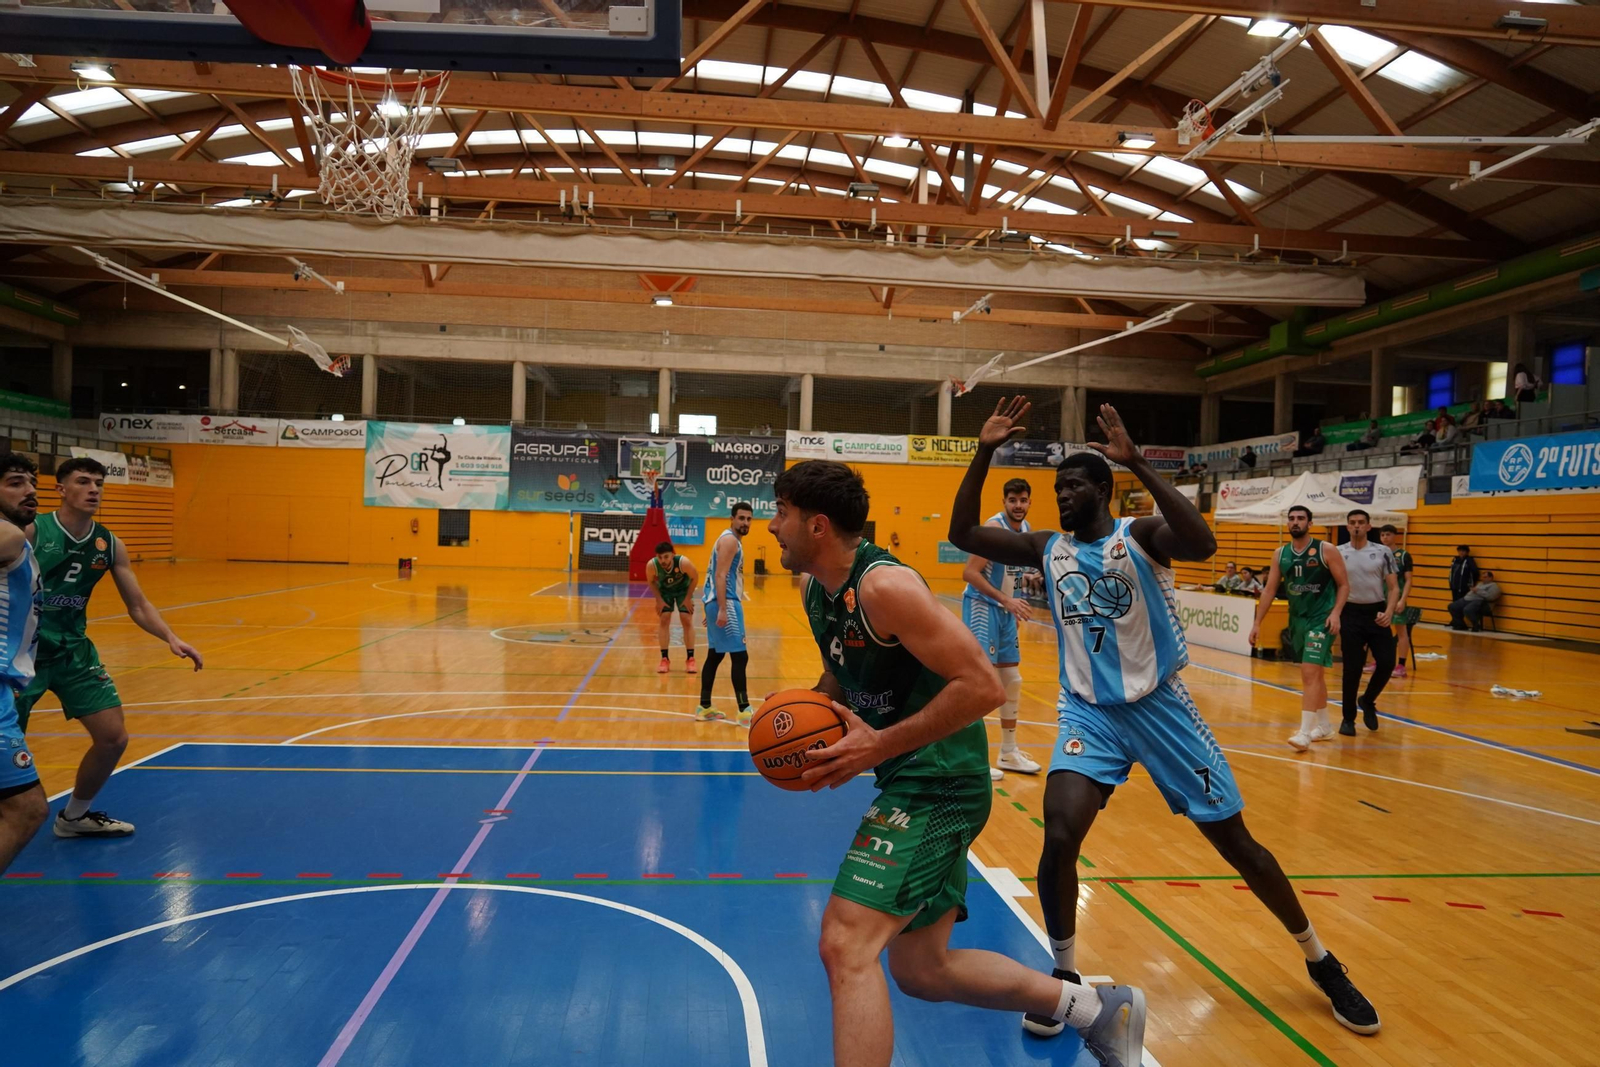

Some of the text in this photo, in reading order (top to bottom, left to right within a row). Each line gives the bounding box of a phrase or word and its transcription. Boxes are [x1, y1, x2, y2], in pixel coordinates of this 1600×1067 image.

[120, 418, 153, 430] nex
[214, 426, 255, 437] Sercasa
[301, 428, 364, 437] CAMPOSOL
[844, 442, 903, 452] CAMPOEJIDO
[932, 438, 979, 452] NOCTUA
[103, 463, 126, 477] clean
[707, 465, 763, 485] wiber
[63, 562, 83, 583] 2
[1294, 565, 1303, 577] 11
[1088, 626, 1107, 654] 7
[1192, 766, 1212, 795] 7
